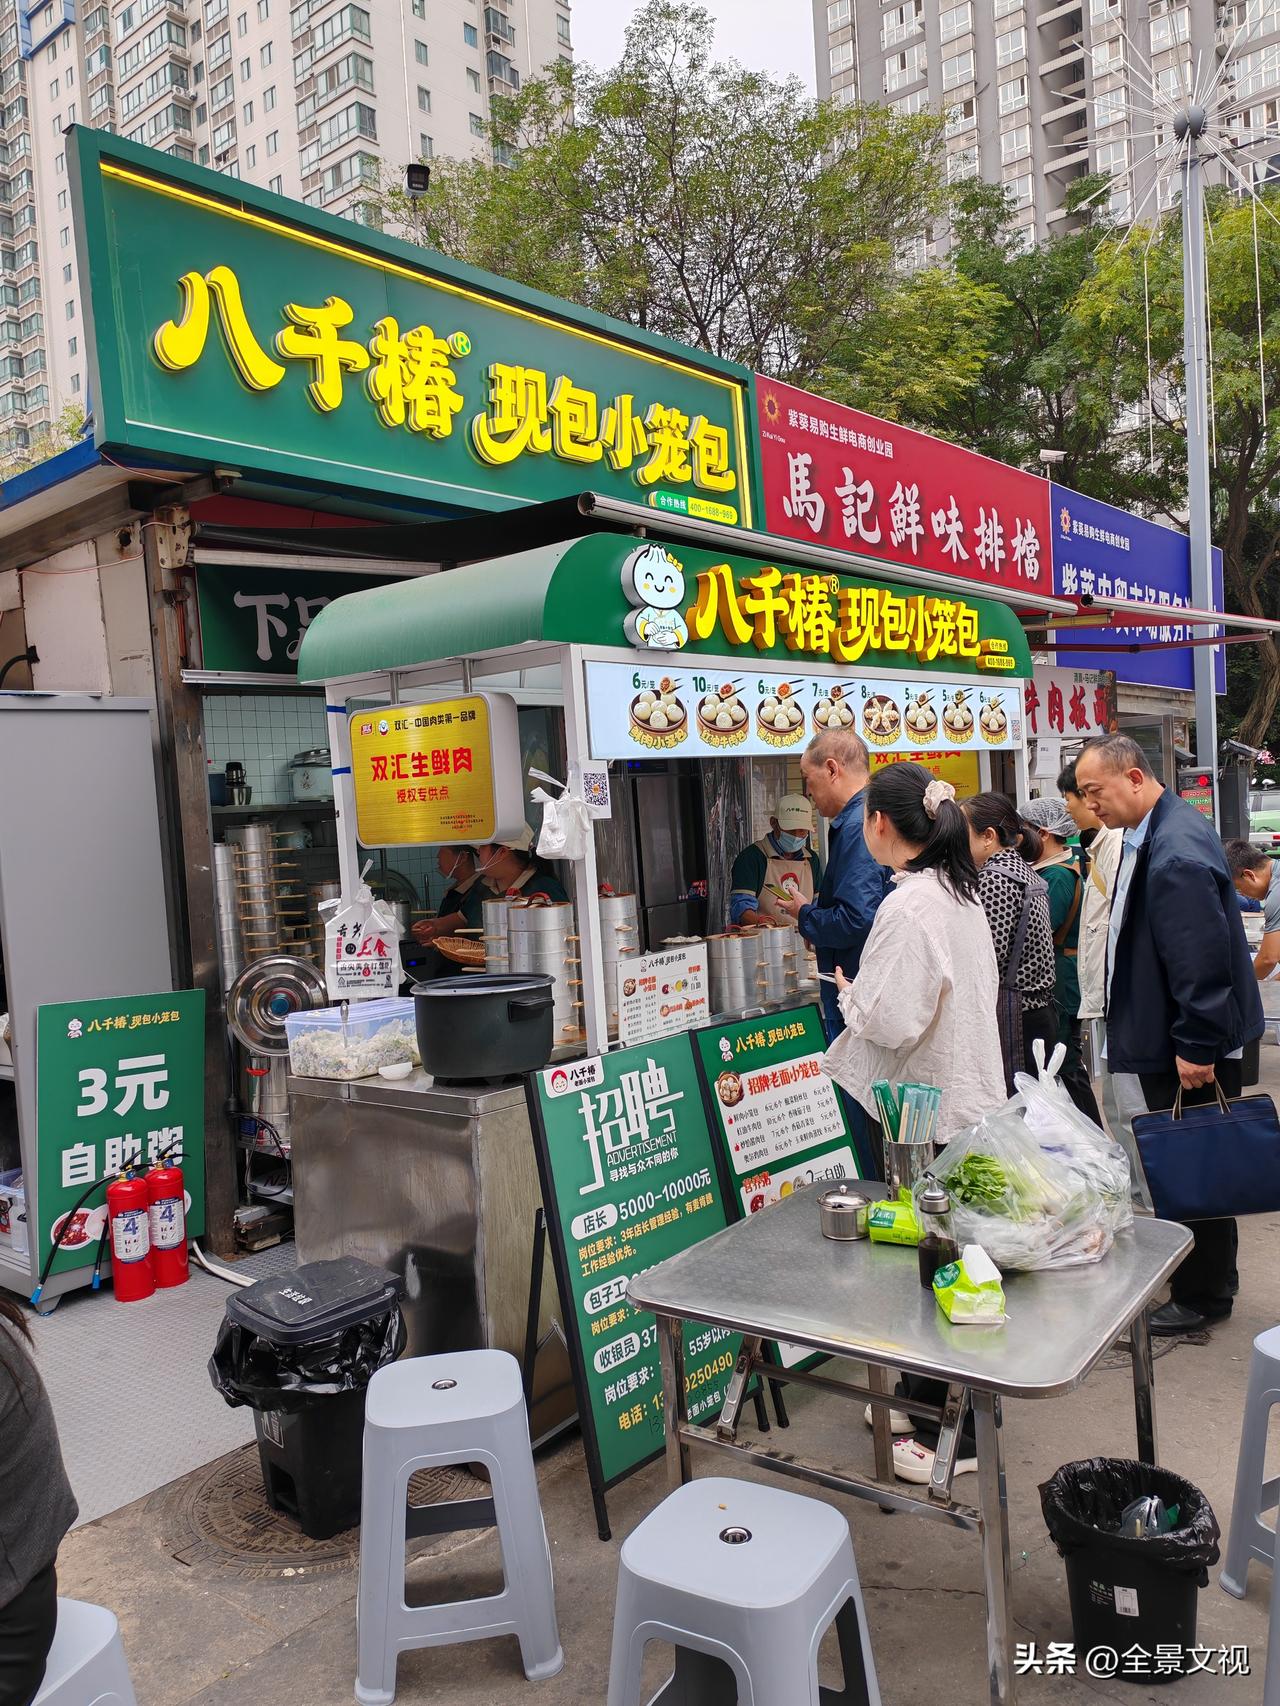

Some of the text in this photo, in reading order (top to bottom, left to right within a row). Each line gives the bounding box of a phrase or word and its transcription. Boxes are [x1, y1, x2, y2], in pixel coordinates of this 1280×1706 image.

[788, 408, 894, 458] 紫葵易购生鲜电商创业园
[660, 496, 686, 510] 合作热线
[783, 451, 1040, 581] 馬記鮮味排檔
[370, 746, 472, 781] 双汇生鲜肉
[396, 786, 450, 804] 授权专供点
[76, 1054, 170, 1117] 3元
[747, 1061, 820, 1096] 招牌老面小笼包
[578, 1058, 684, 1196] 招聘
[61, 1126, 184, 1188] 自助粥
[606, 1132, 677, 1167] ADVERTISEMENT
[609, 1148, 680, 1182] 寻找与众不同的你
[742, 1170, 772, 1194] 营养粥
[160, 1204, 174, 1222] 4
[583, 1168, 712, 1234] 店长 5000-10000元
[123, 1218, 138, 1235] 4
[590, 1280, 626, 1310] 包子工
[600, 1336, 636, 1369] 收银员
